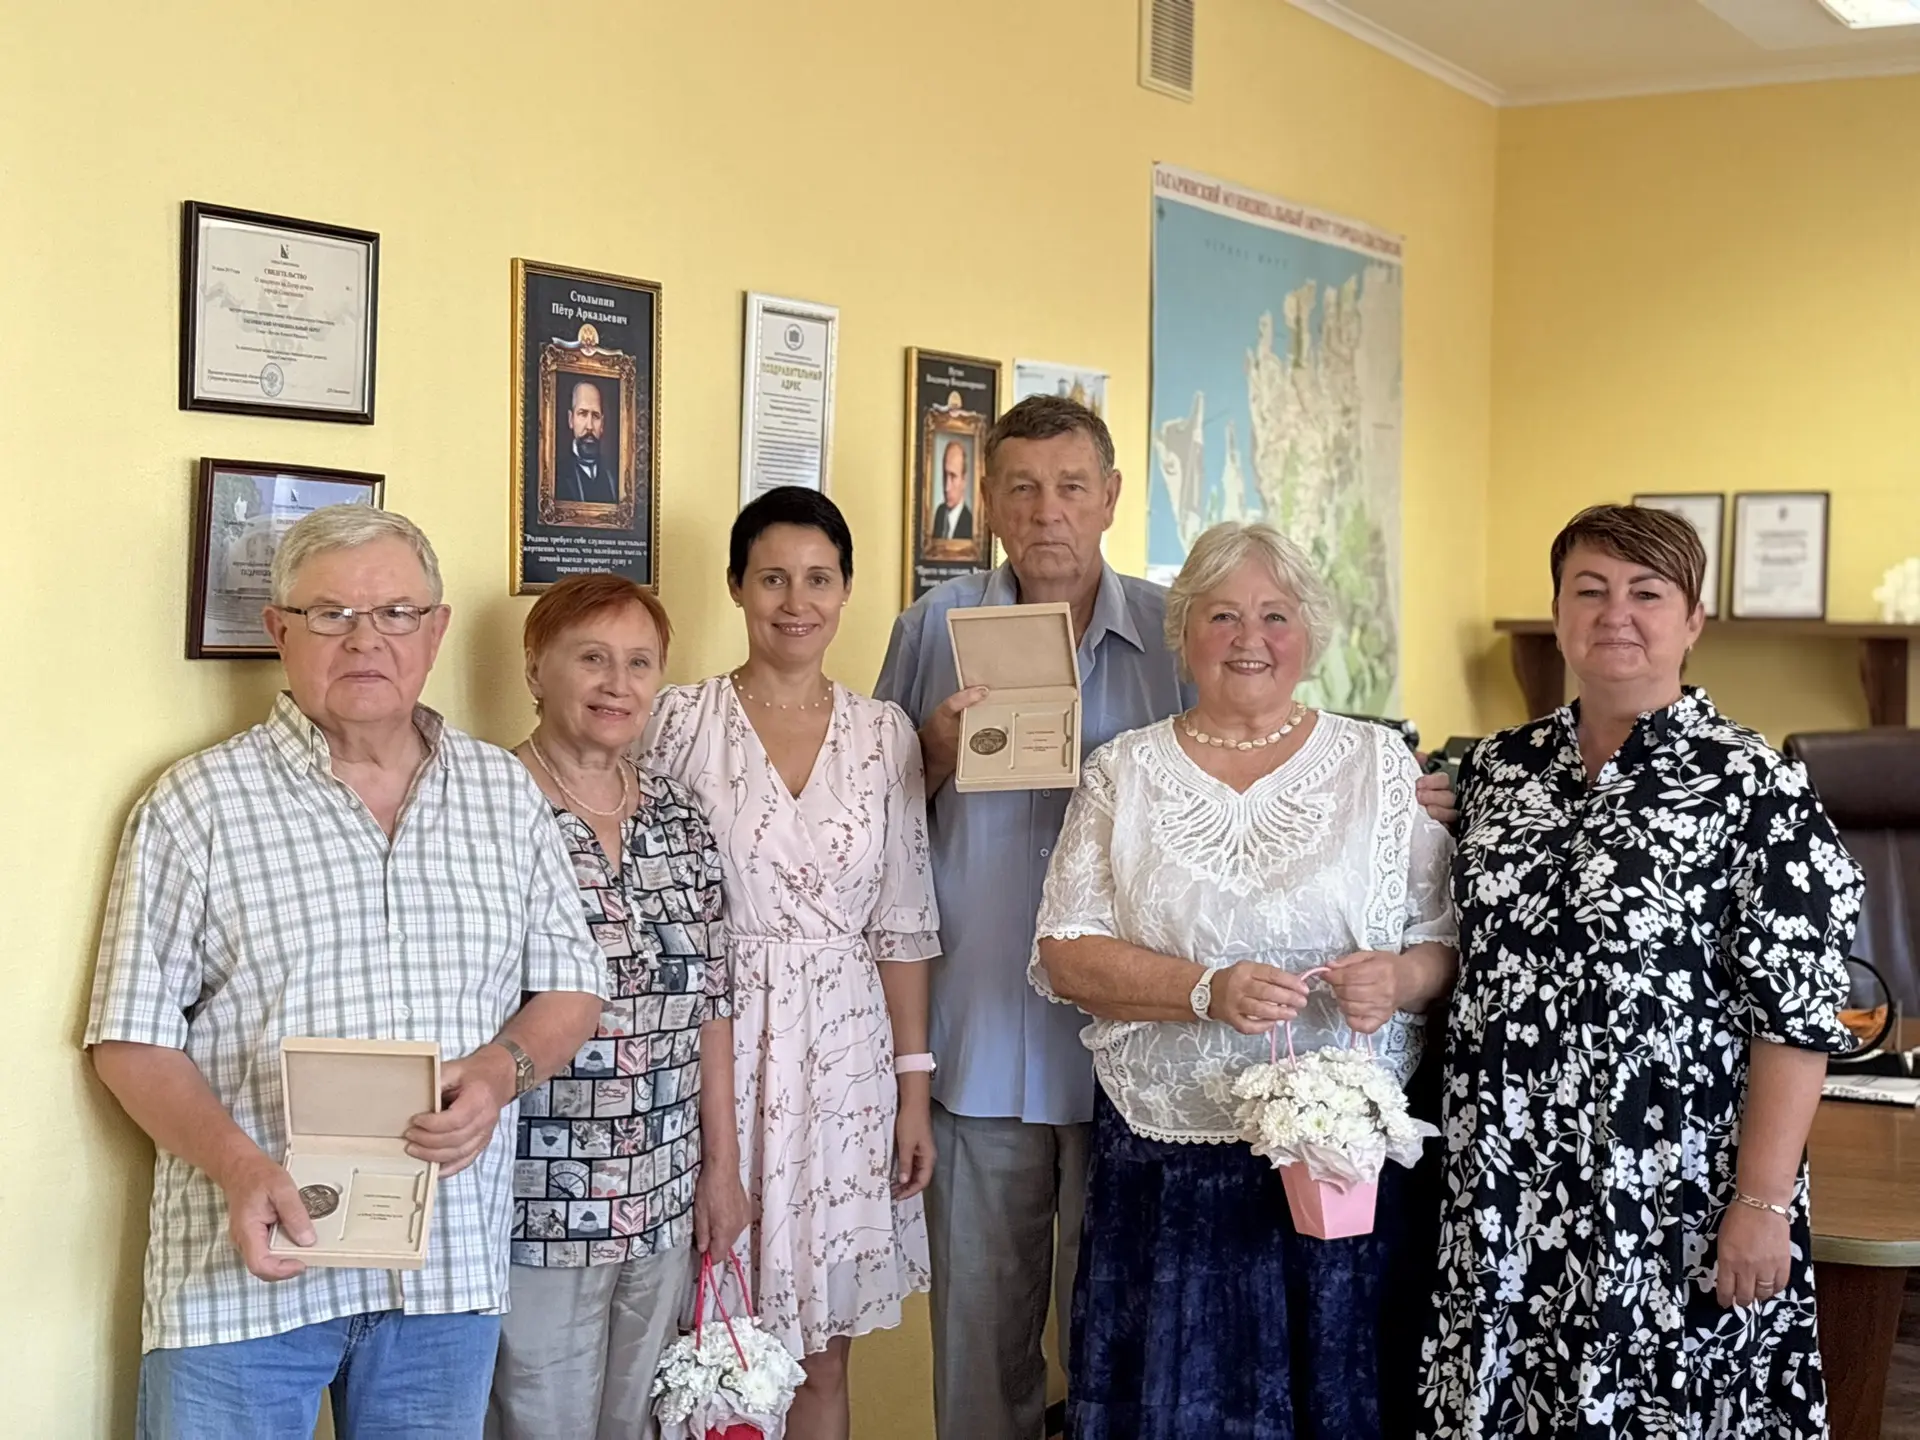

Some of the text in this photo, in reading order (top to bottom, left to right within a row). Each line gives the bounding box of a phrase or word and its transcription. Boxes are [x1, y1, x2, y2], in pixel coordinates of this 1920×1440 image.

[570, 290, 615, 308] Столыпин
[552, 302, 628, 325] Пётр Аркадьевич
